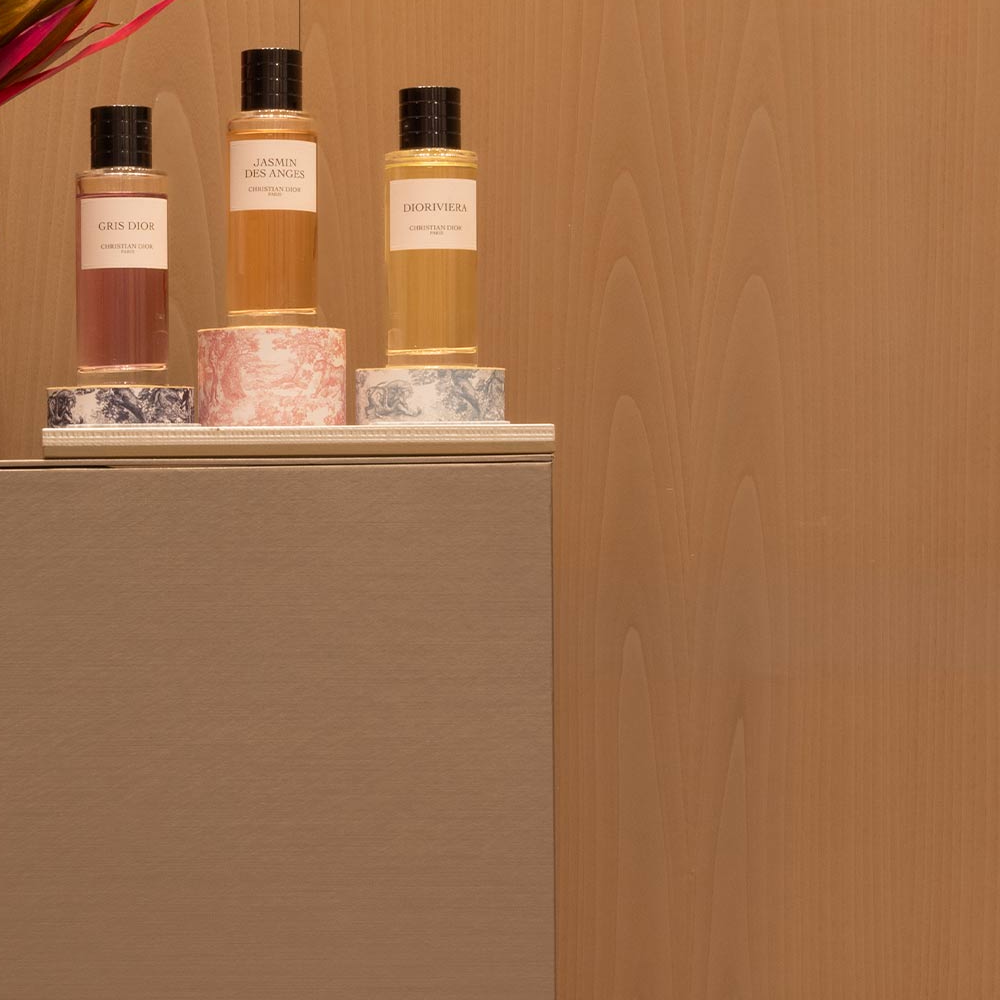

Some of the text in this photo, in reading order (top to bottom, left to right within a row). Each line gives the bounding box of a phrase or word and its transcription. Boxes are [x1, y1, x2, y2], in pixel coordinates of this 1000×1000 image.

[253, 158, 297, 167] JASMIN
[245, 169, 305, 179] DES ANGES
[403, 203, 467, 213] DIORIVIERA
[98, 221, 155, 231] GRIS DIOR
